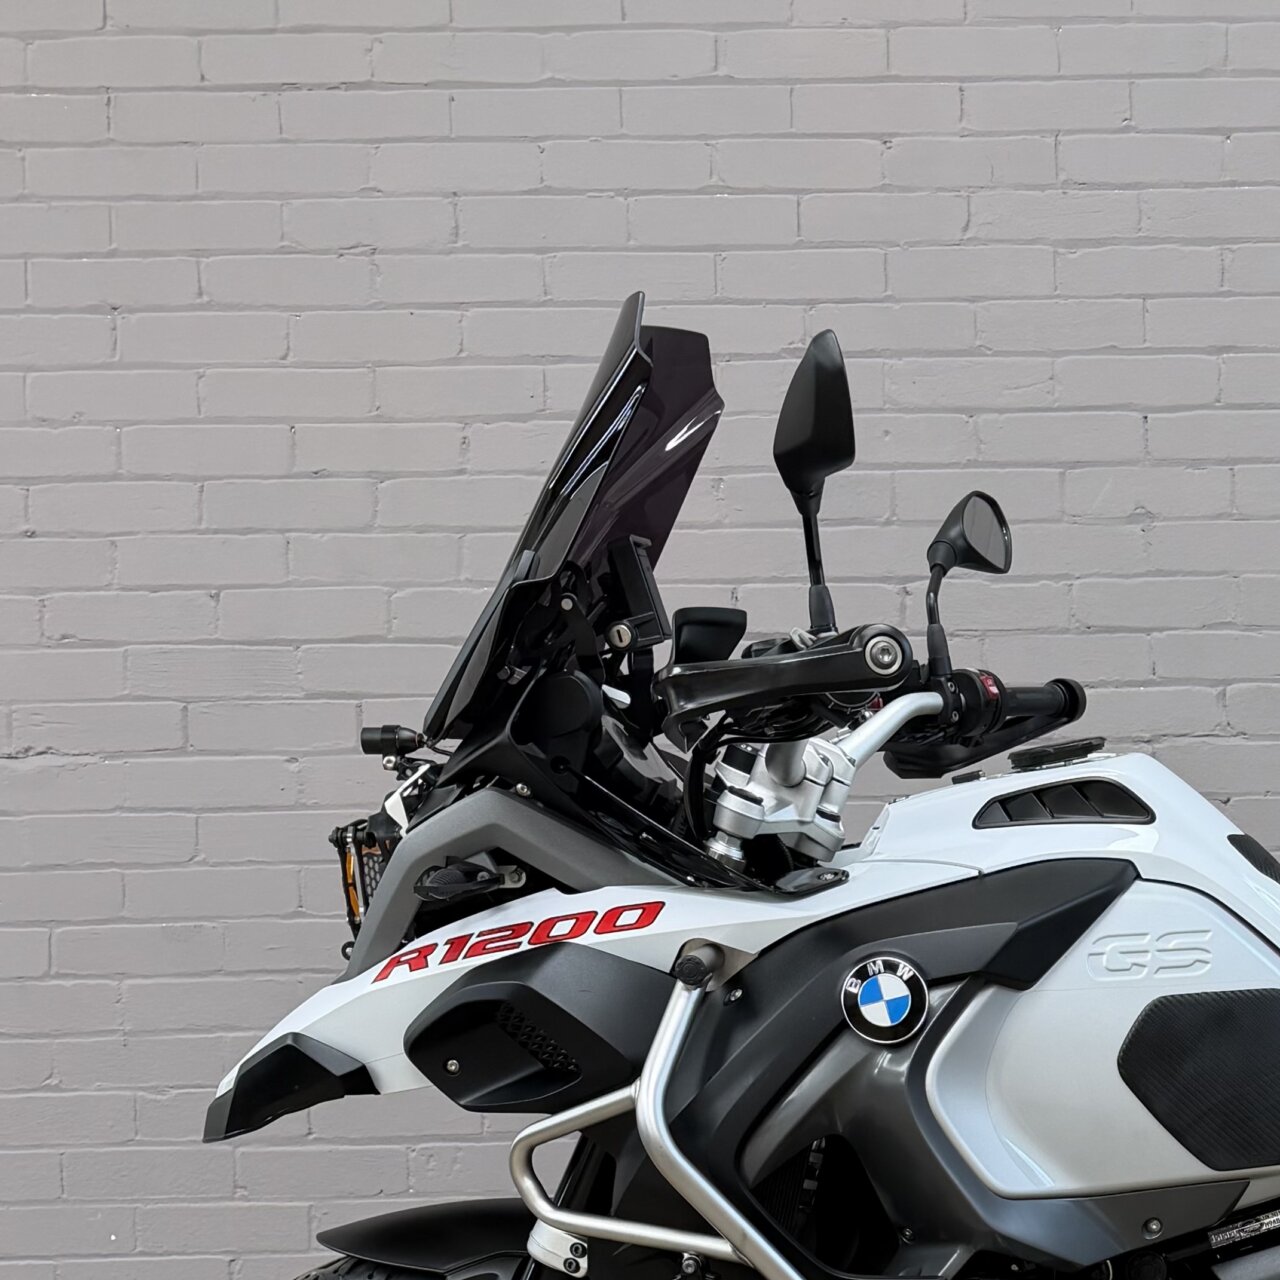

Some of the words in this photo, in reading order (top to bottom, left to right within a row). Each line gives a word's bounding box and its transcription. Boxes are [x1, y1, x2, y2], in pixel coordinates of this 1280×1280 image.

[372, 901, 666, 983] R1200
[1087, 930, 1212, 981] GS
[845, 960, 915, 994] BMW
